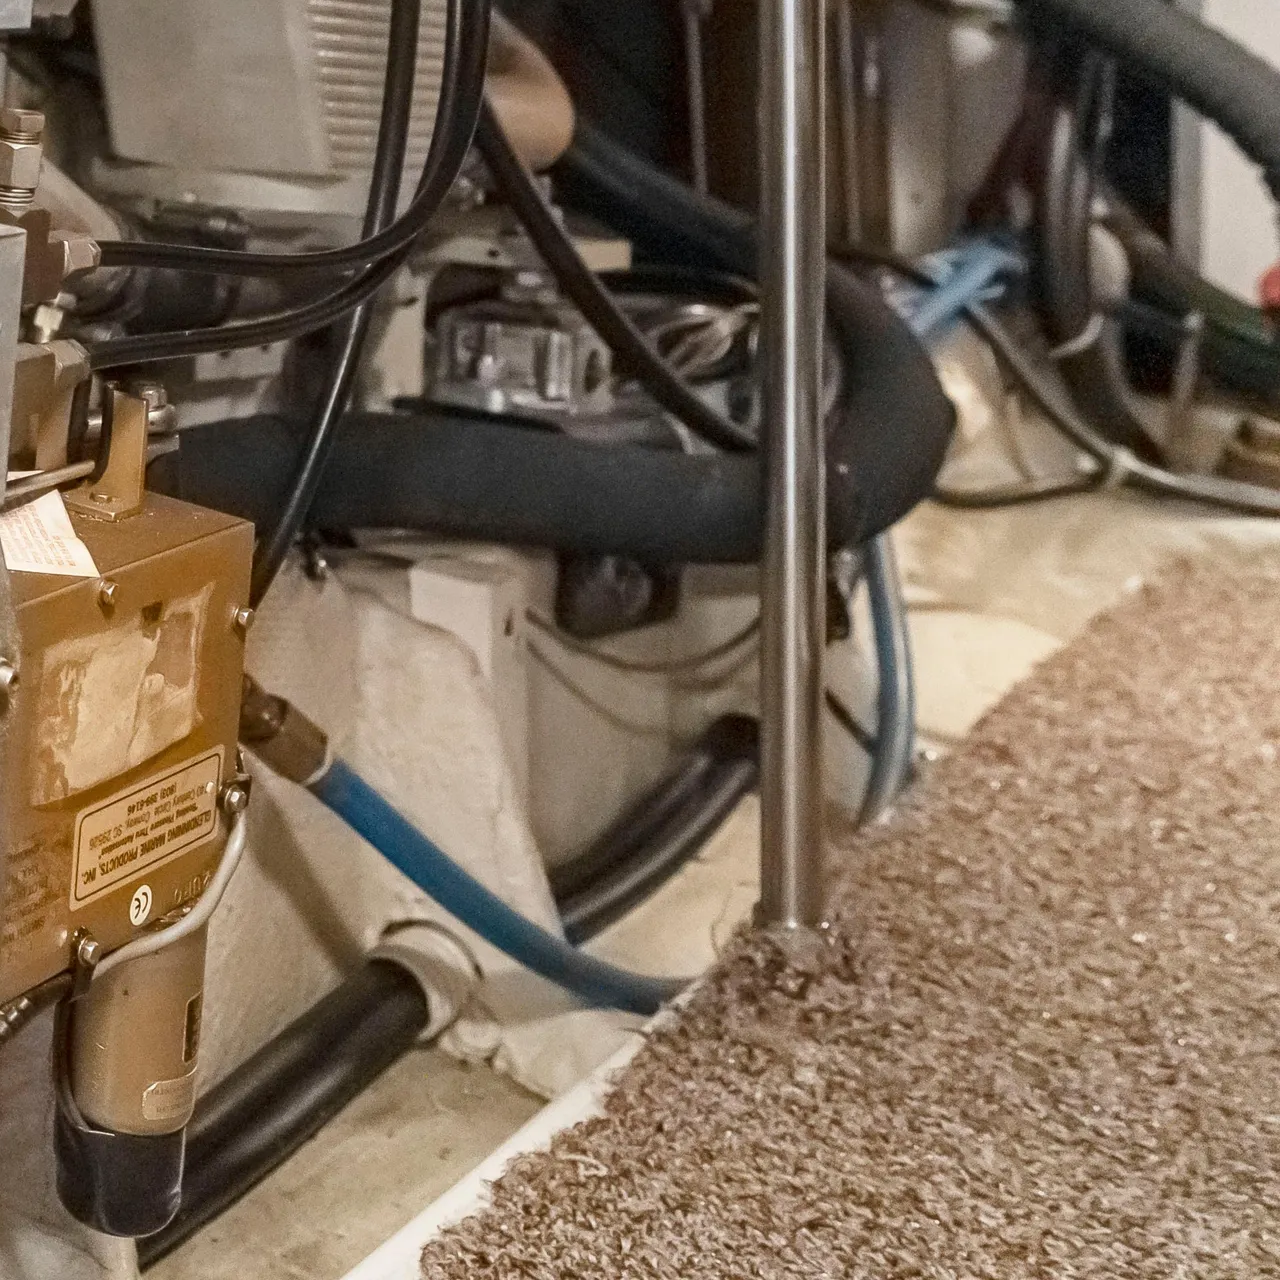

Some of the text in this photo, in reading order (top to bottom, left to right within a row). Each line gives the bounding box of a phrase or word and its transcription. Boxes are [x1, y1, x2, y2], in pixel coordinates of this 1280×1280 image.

[167, 810, 211, 842] GLENDINNING
[140, 832, 166, 857] MARINE
[81, 867, 97, 884] INC.
